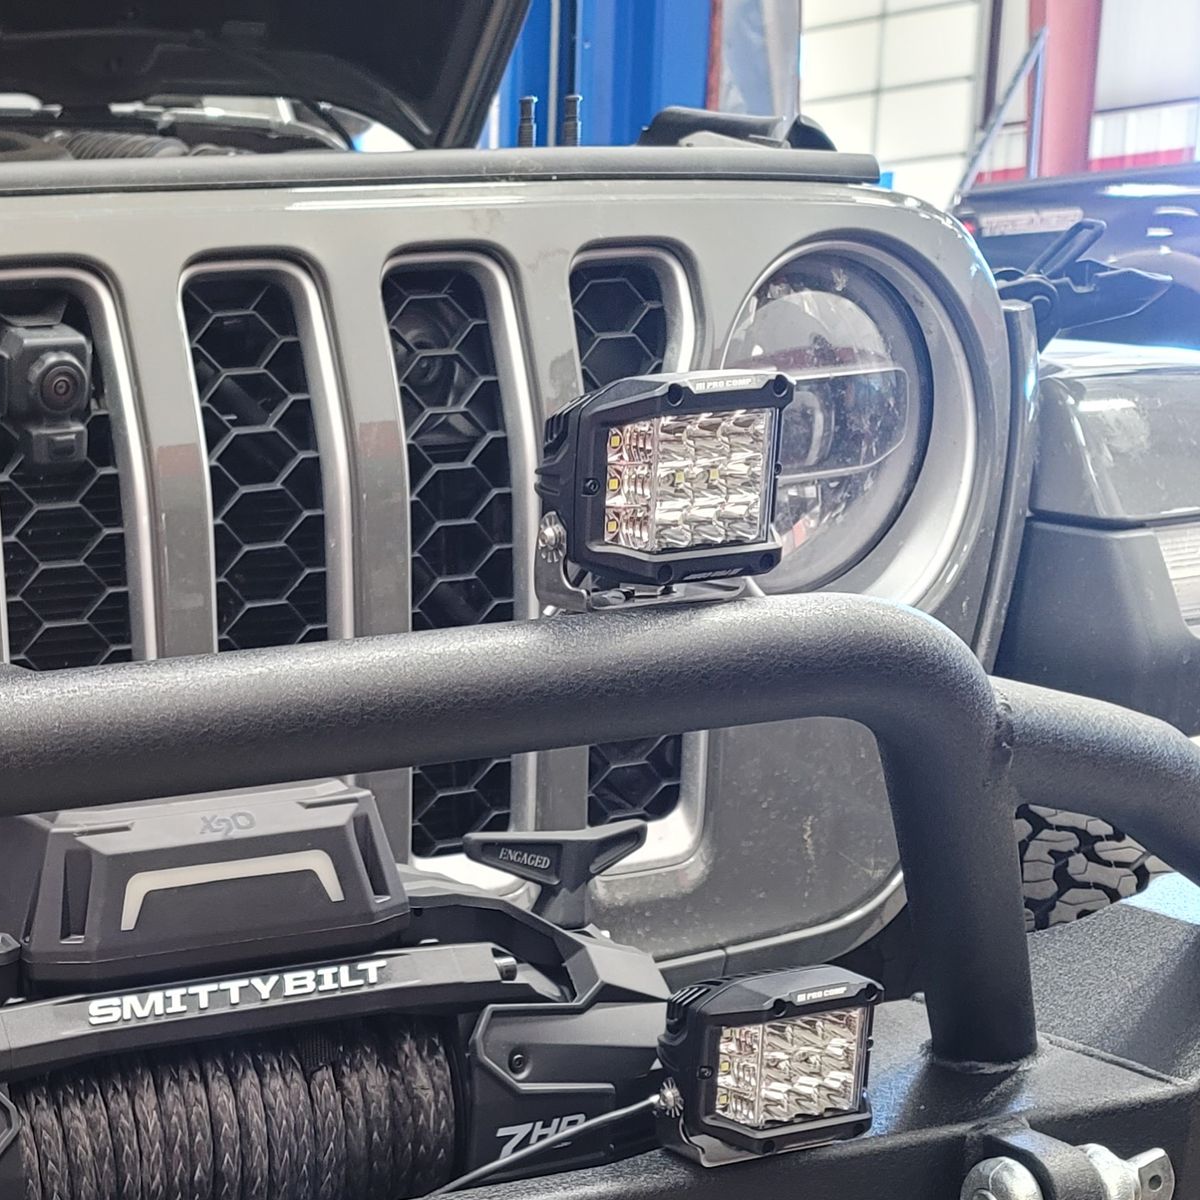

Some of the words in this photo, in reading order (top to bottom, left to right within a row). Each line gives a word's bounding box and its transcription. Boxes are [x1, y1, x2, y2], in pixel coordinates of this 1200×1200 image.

[706, 381, 725, 390] PRO
[725, 378, 752, 388] COMP
[498, 847, 551, 869] ENGAGED
[88, 960, 388, 1026] SMITTYBILT
